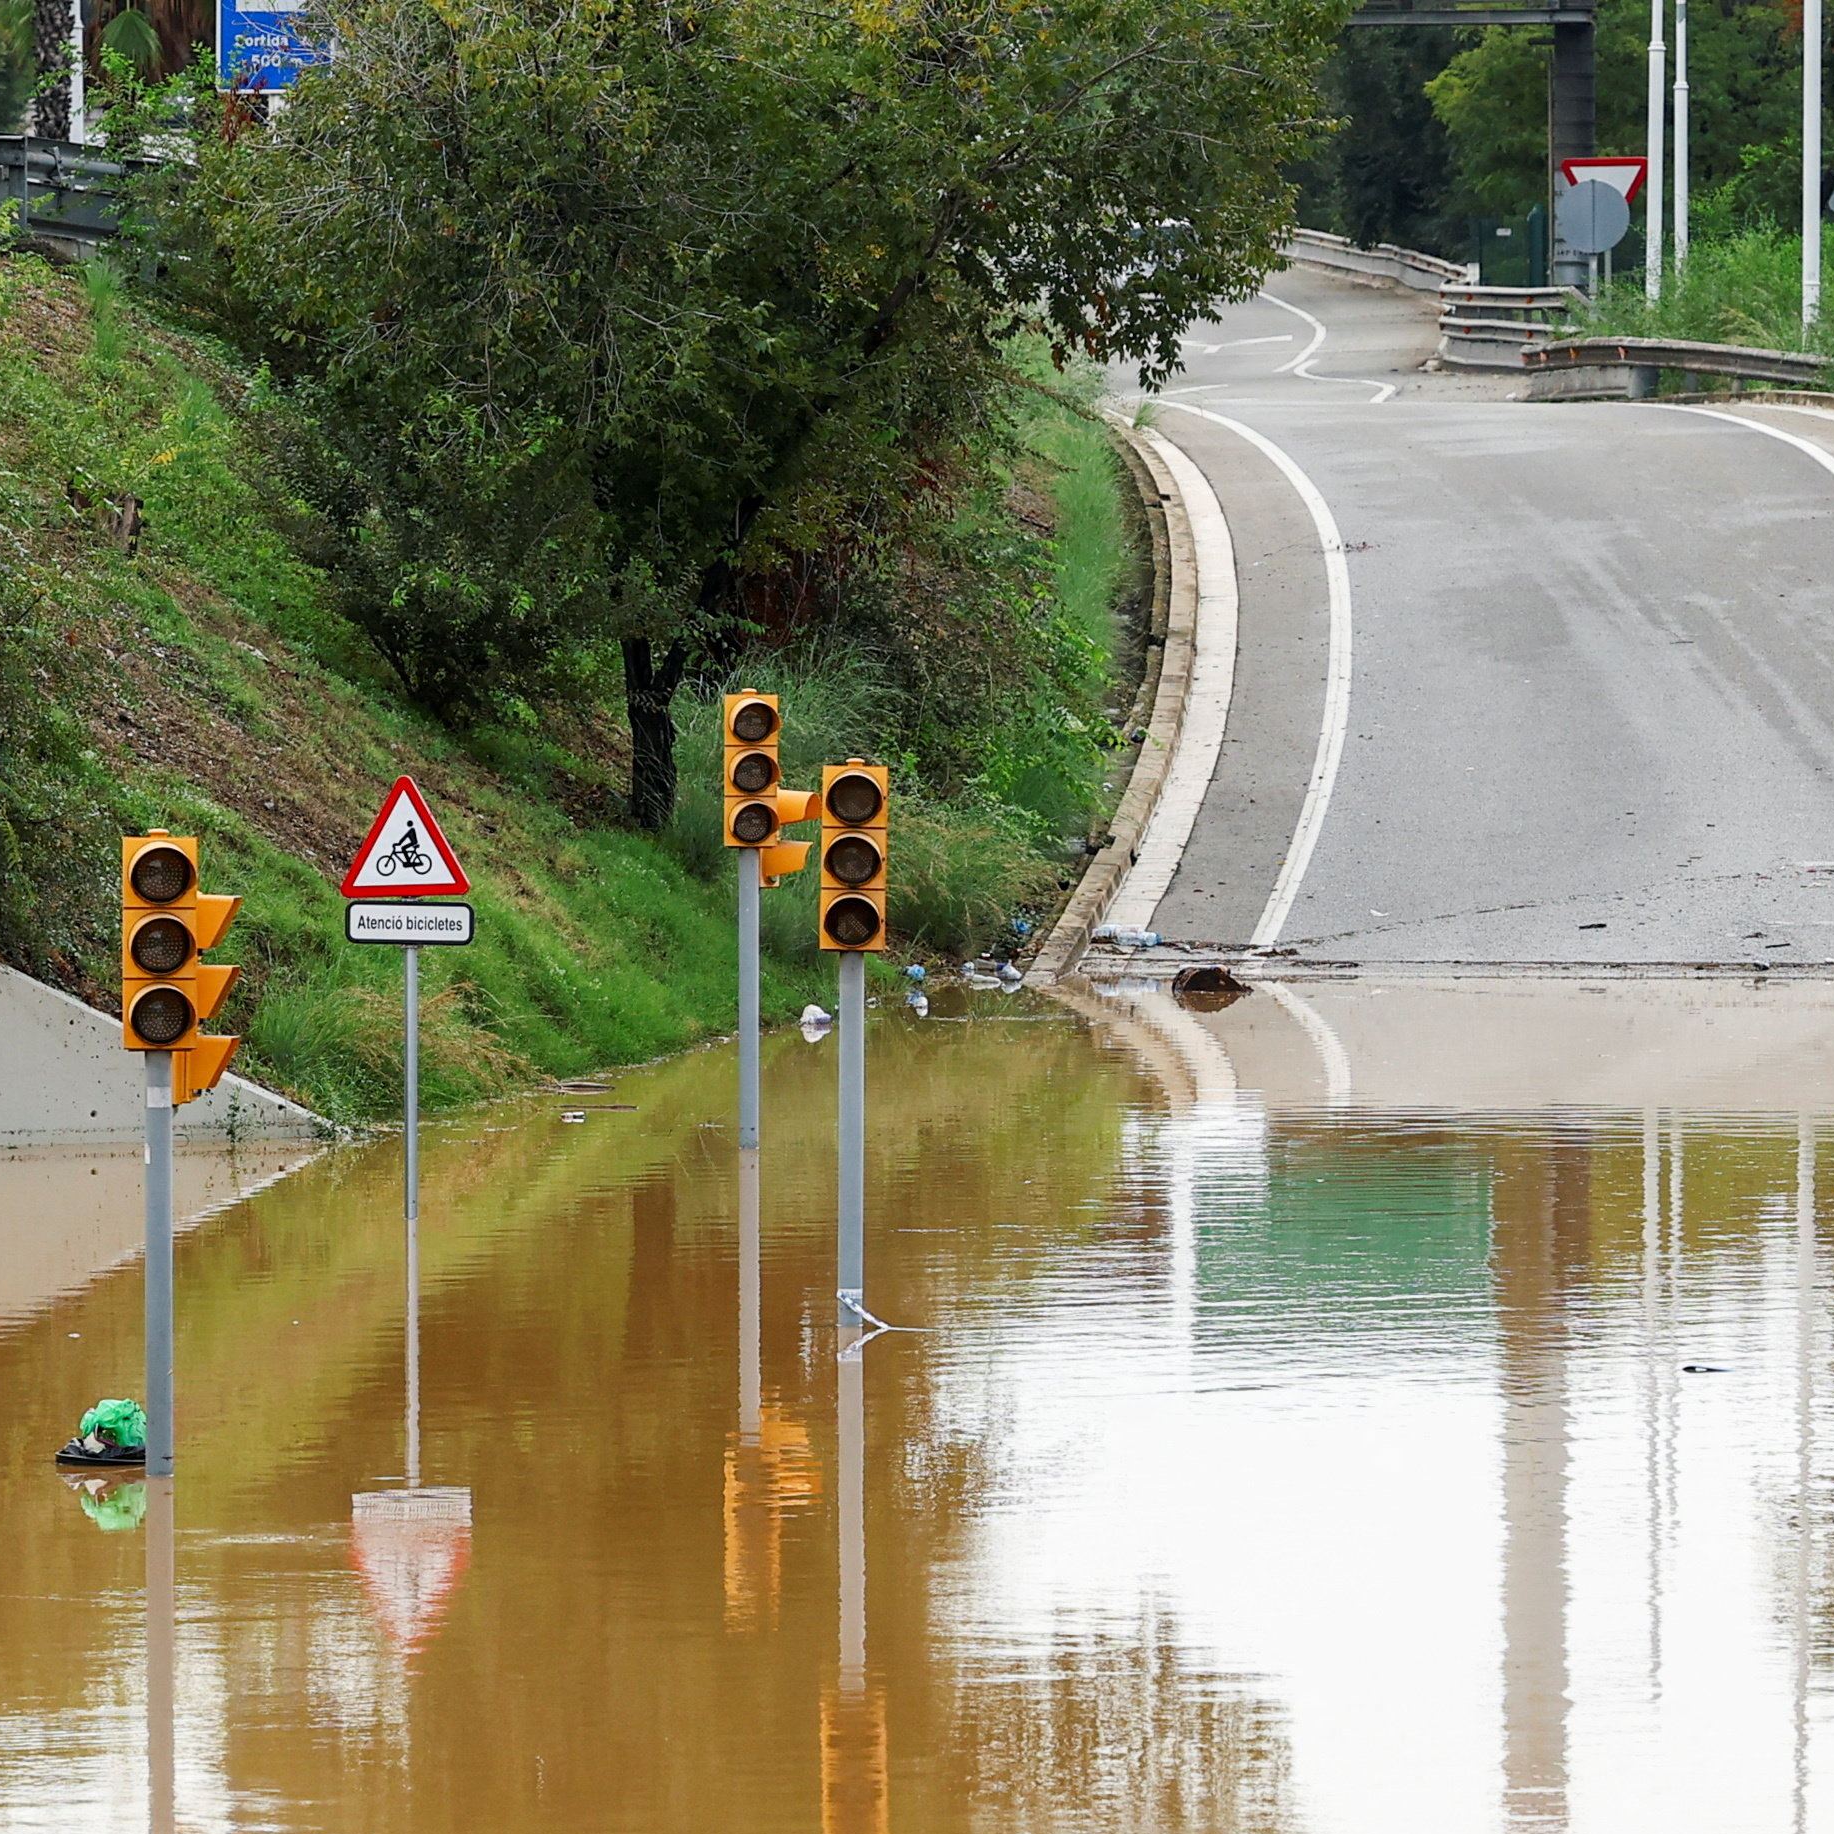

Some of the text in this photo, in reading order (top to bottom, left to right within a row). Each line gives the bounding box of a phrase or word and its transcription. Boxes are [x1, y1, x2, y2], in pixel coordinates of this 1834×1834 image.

[251, 54, 281, 67] 500
[357, 914, 463, 931] Atenció bicicletes
